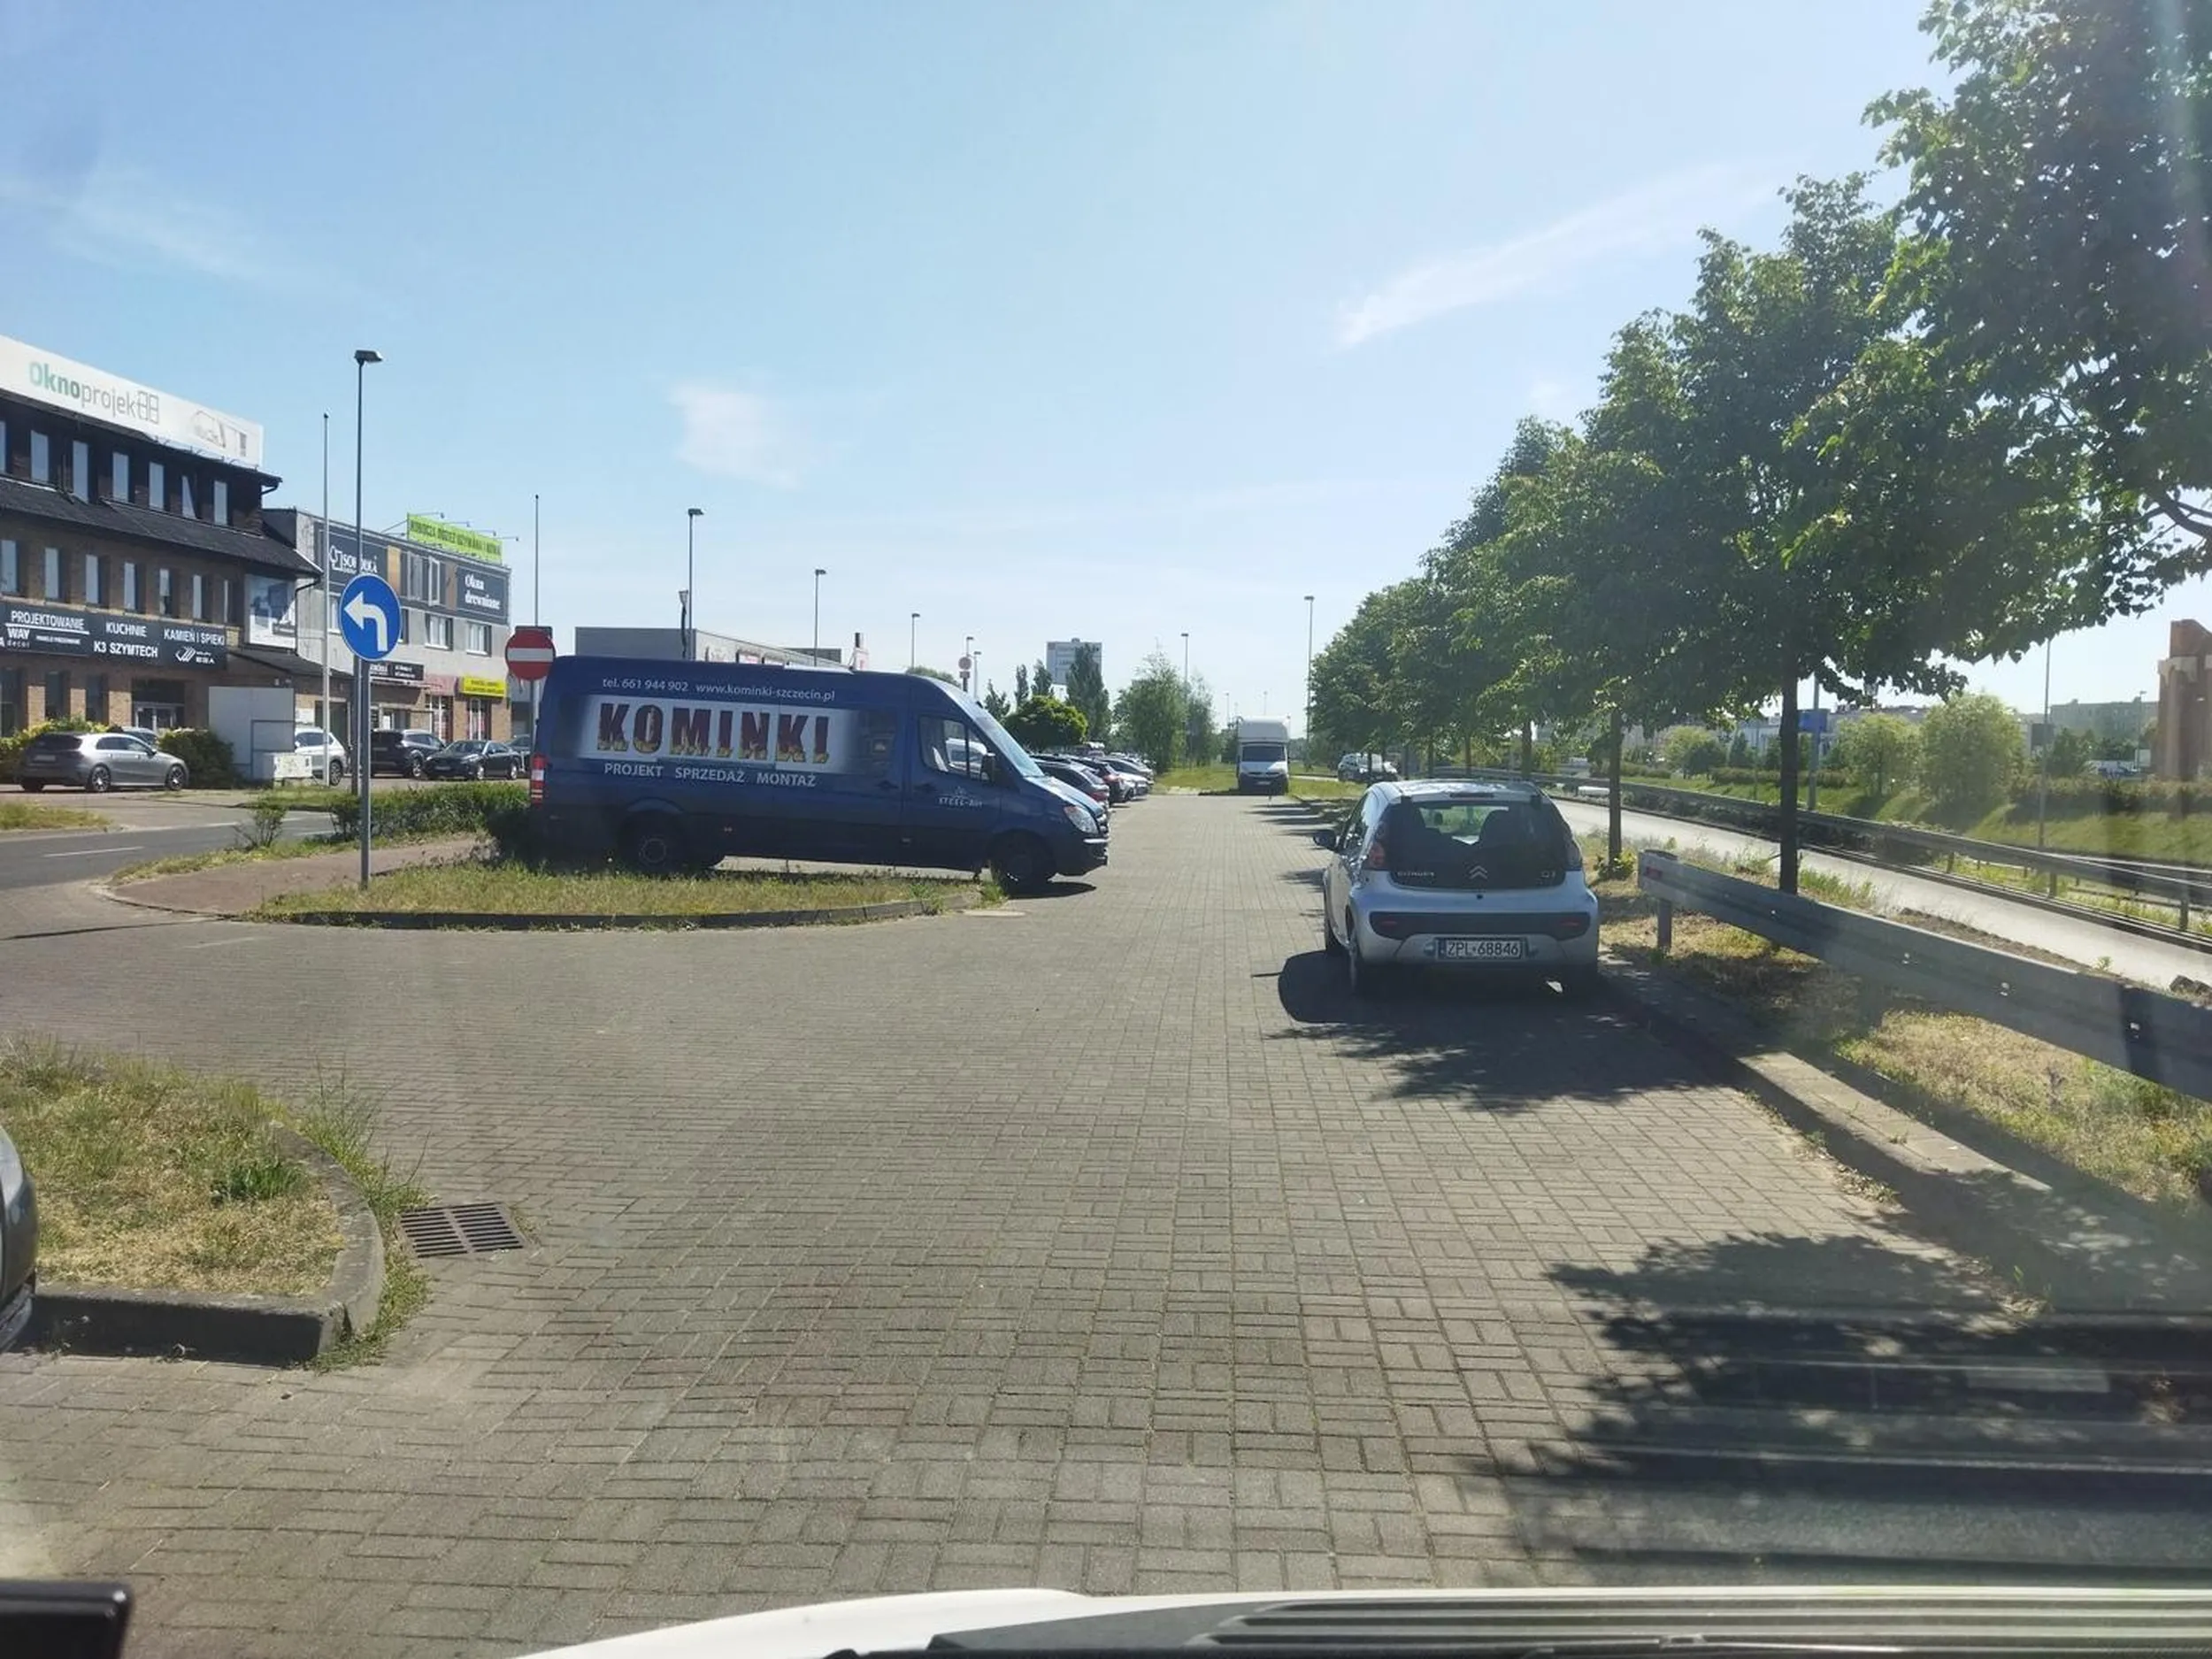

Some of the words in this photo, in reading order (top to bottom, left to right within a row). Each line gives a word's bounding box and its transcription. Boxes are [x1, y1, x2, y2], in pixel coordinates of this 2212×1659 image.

[11, 610, 85, 631] PROJEKTOWANIE
[105, 622, 148, 638] KUCHNIE
[7, 627, 30, 640] WAY
[93, 641, 107, 653] K3
[109, 642, 159, 658] SZYMTECH
[603, 679, 620, 688] tel.
[622, 679, 641, 690] 661
[644, 680, 665, 691] 944
[667, 680, 689, 693] 902
[695, 684, 836, 702] www.kominki-szczecin.pl
[596, 703, 830, 764] KOMINKI
[604, 763, 664, 777] PROJEKT
[675, 766, 745, 783] SPRZEDAŻ
[757, 772, 817, 787] MONTAŻ
